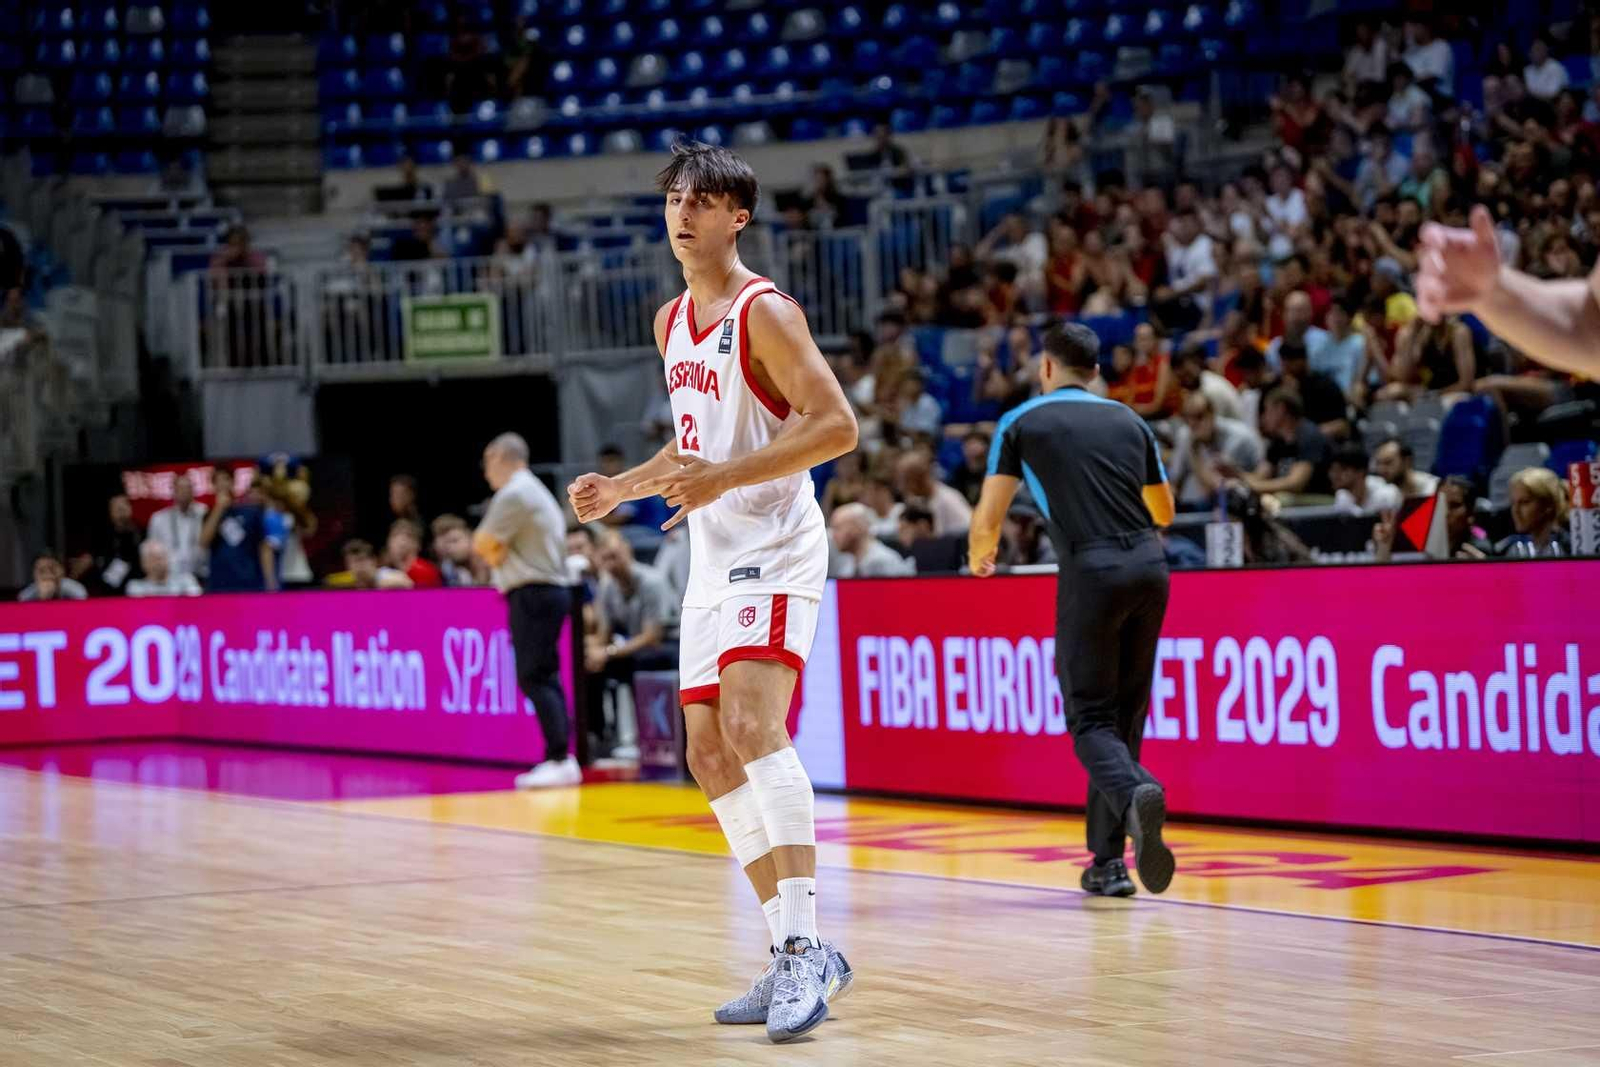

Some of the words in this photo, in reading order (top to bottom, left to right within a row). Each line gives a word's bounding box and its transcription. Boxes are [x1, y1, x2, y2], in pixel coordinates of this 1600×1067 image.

[83, 625, 203, 704] 2029
[209, 629, 329, 707] Candidate
[331, 628, 427, 711] Nation
[857, 635, 939, 730] FIBA
[943, 636, 1205, 741] EUROBET
[1212, 635, 1340, 748] 2029
